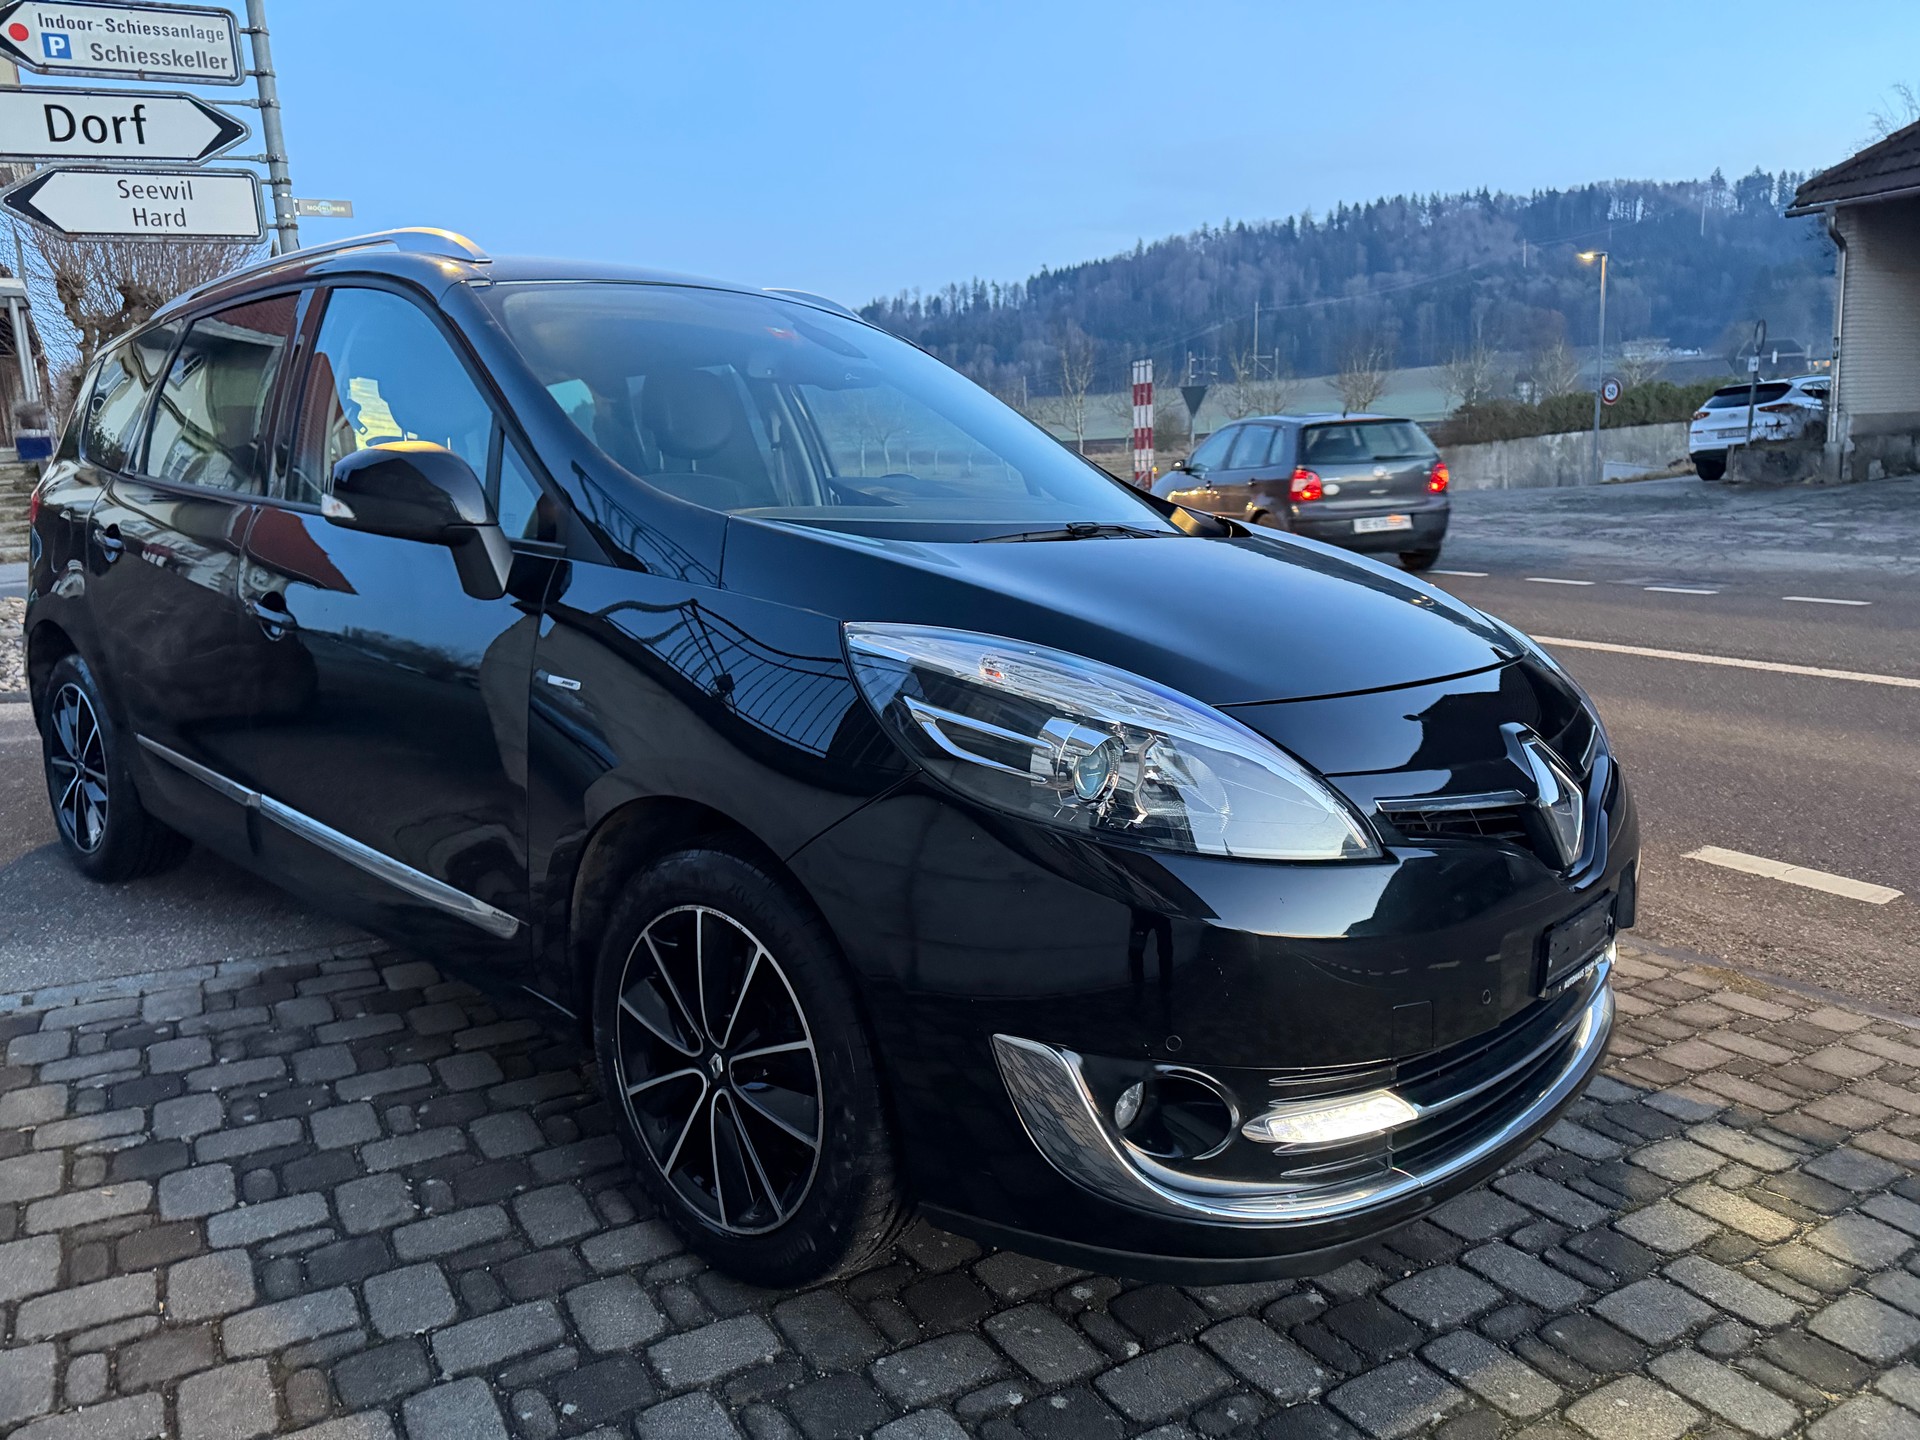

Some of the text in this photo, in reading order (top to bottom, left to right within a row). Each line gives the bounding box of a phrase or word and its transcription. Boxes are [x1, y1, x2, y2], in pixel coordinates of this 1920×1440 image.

[38, 13, 224, 43] Indoor-Schiessanlage
[49, 37, 65, 56] P
[90, 43, 228, 70] Schiesskeller
[44, 104, 146, 145] Dorf
[117, 179, 193, 200] Seewil
[133, 207, 187, 228] Hard
